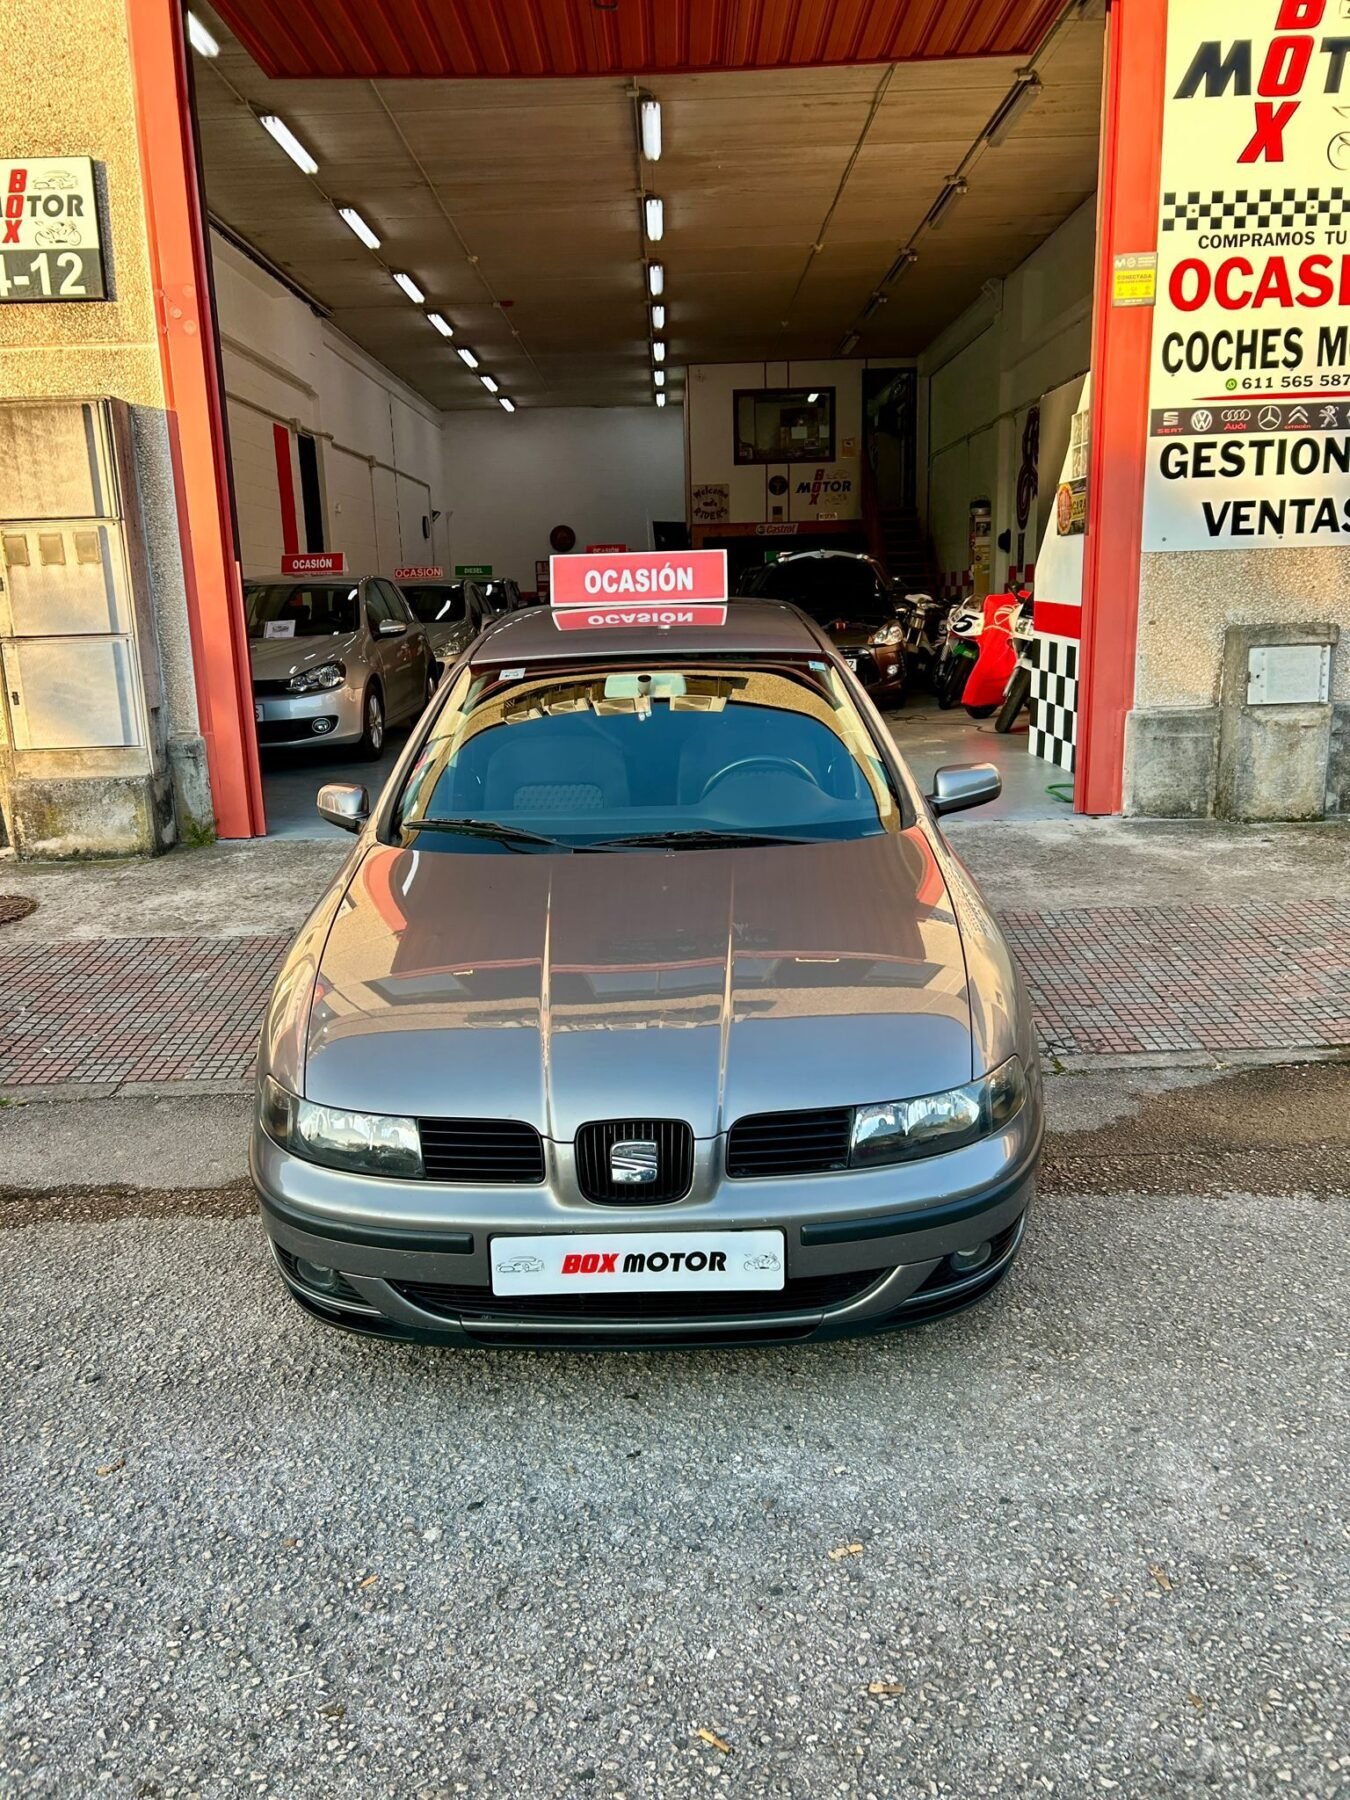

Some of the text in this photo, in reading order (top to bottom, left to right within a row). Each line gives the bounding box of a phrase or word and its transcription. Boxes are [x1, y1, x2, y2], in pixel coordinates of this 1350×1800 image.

[2, 168, 28, 244] BOX
[1198, 230, 1348, 250] COMPRAMOS TU
[1162, 326, 1350, 374] COCHES M
[1242, 374, 1350, 389] 611 565 587
[1224, 423, 1247, 431] Audi
[795, 481, 852, 494] MOTOR
[292, 556, 332, 569] OCASIÓN
[584, 562, 693, 594] OCASIÓN
[952, 614, 979, 632] 5
[561, 1251, 727, 1274] BOX MOTOR
